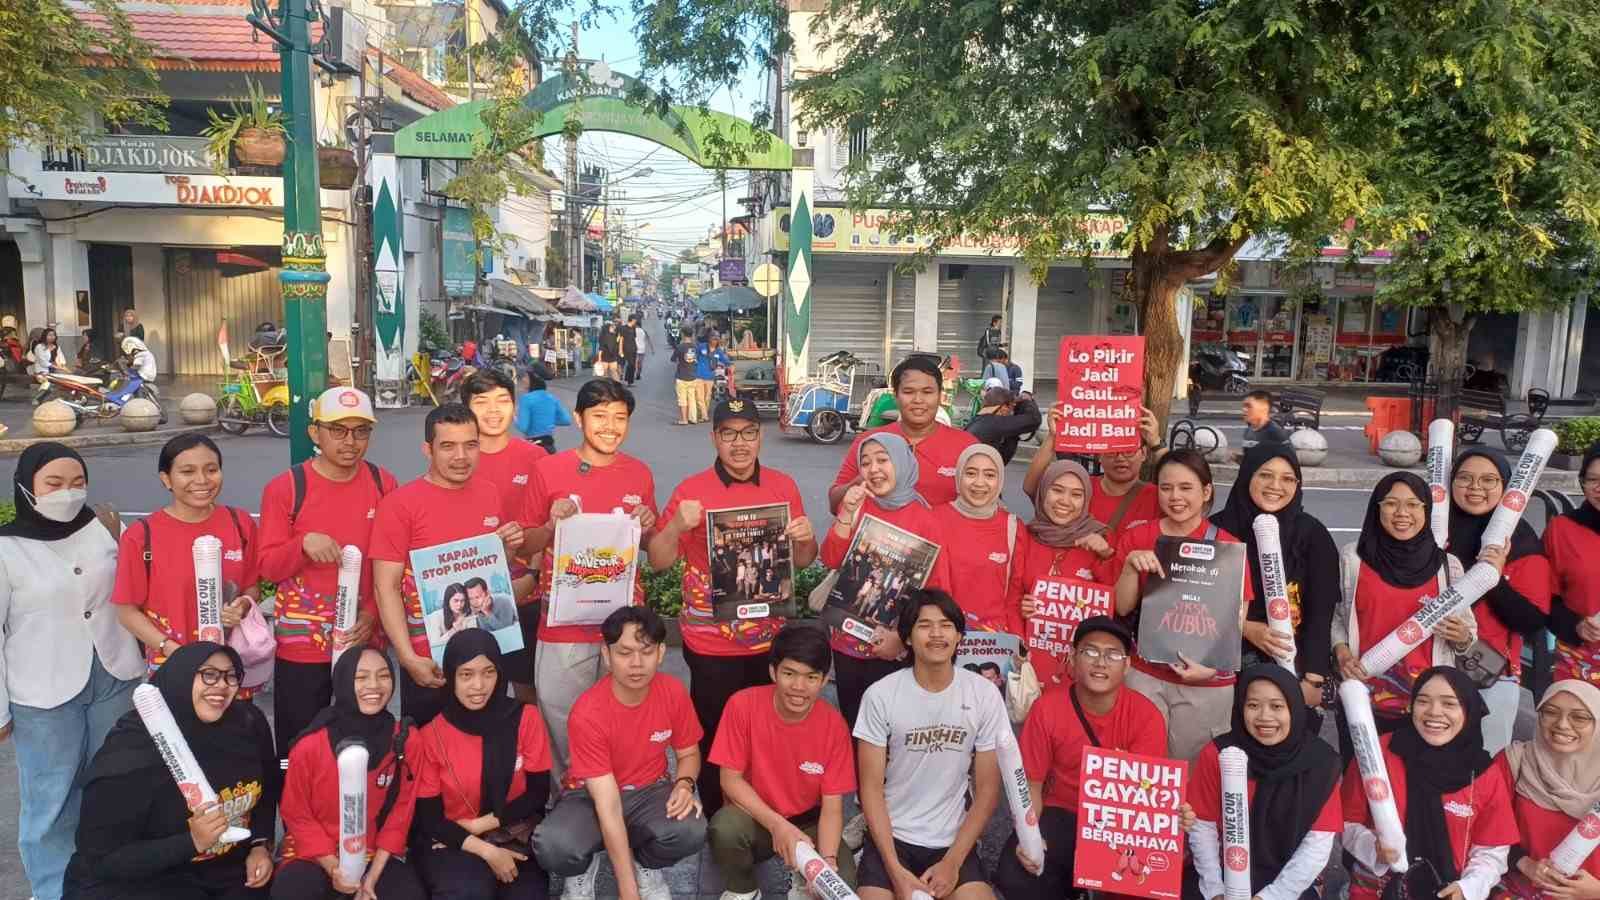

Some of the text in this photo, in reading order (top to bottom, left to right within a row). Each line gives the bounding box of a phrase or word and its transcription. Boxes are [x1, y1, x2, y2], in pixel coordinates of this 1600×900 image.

[87, 147, 197, 167] DJAKDJOK
[177, 186, 273, 205] DJAKDJOK
[1069, 348, 1134, 363] Lo Pikir
[1081, 368, 1119, 382] Jadi
[1063, 404, 1136, 418] Padalah
[1061, 422, 1135, 437] Jadi Bau
[438, 546, 479, 564] KAPAN
[575, 552, 600, 568] SAVE
[422, 554, 498, 580] STOP ROKOK?
[1170, 562, 1207, 574] Merokok
[1262, 553, 1277, 597] SAVE OUR
[199, 578, 210, 625] SAVE OUR
[1034, 580, 1110, 608] PENUH
[1414, 586, 1458, 622] SAVE OUR
[959, 638, 996, 646] KAPAN
[972, 648, 1014, 656] ROKOK?
[1086, 754, 1182, 787] PENUH
[1084, 779, 1180, 810] GAYA(?)
[1082, 803, 1179, 835] TETAPI
[1224, 792, 1236, 844] SAVE OUR
[1081, 827, 1179, 852] BERBAHAYA
